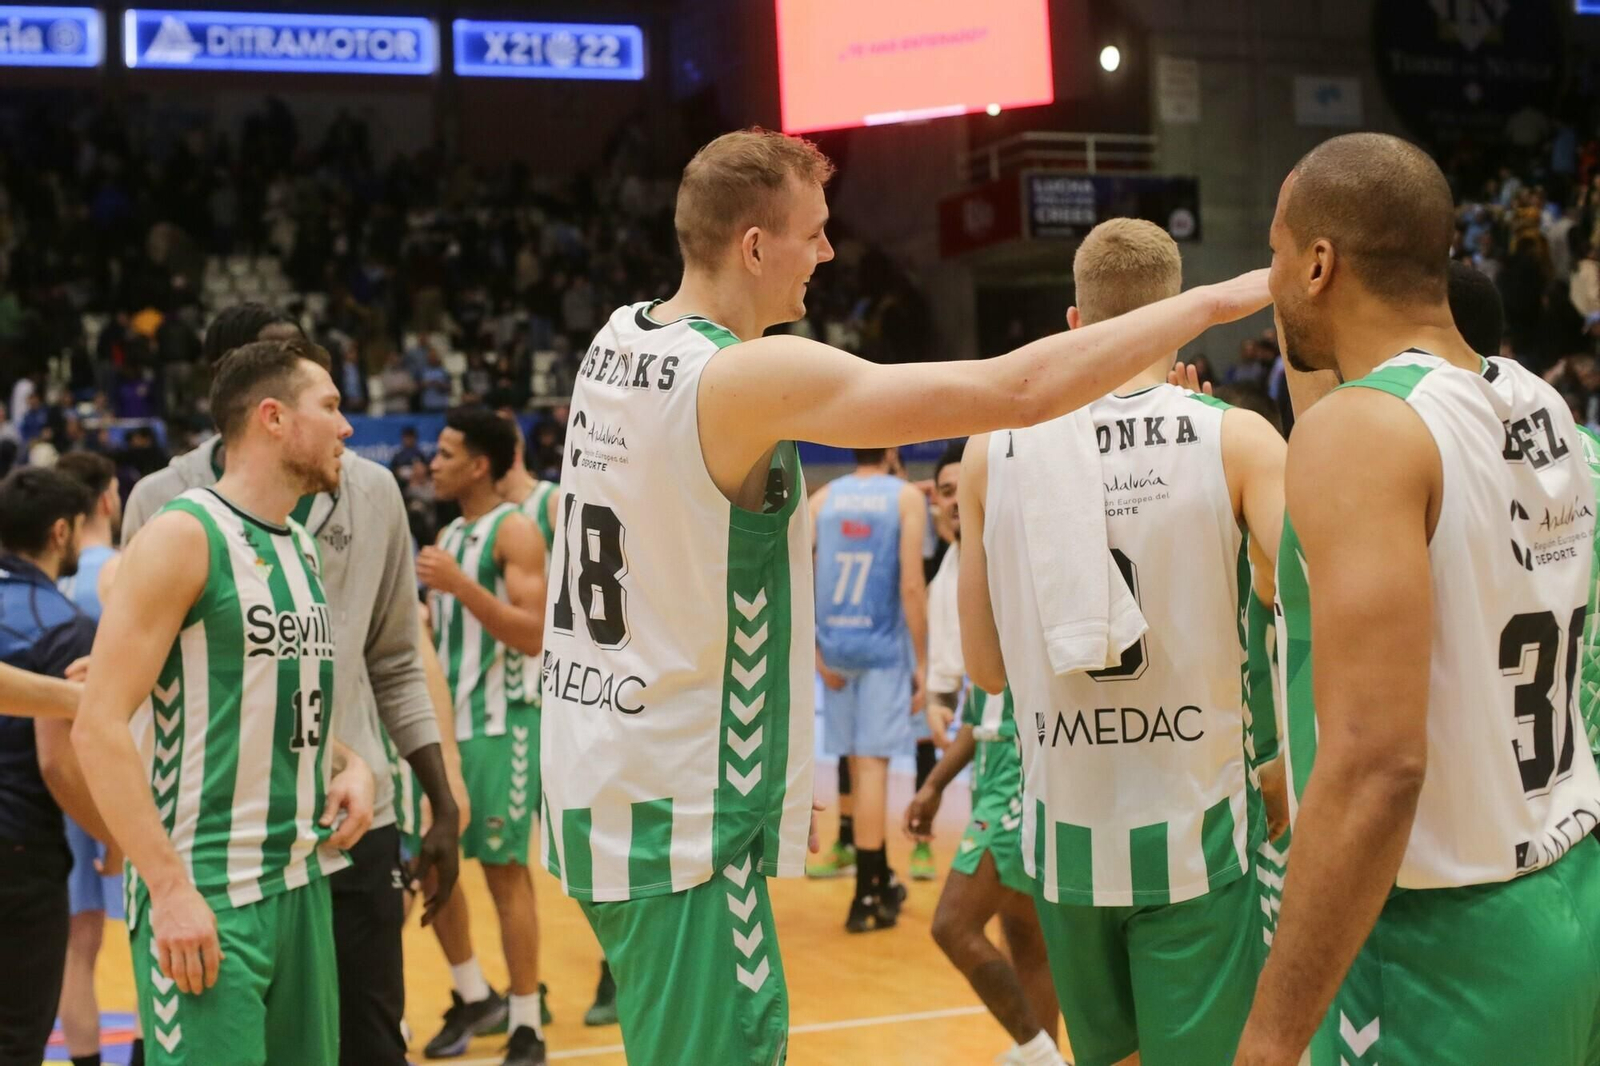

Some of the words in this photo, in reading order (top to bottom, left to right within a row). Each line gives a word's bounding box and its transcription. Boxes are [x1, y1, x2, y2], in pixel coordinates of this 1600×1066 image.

[206, 24, 418, 62] DITRAMOTOR
[1104, 506, 1139, 518] ORTE
[1117, 495, 1153, 506] Europea
[1158, 492, 1170, 500] del
[552, 492, 632, 651] 18
[830, 550, 874, 606] 77
[246, 604, 333, 644] Sevill
[290, 689, 323, 750] 13
[1051, 705, 1205, 748] MEDAC
